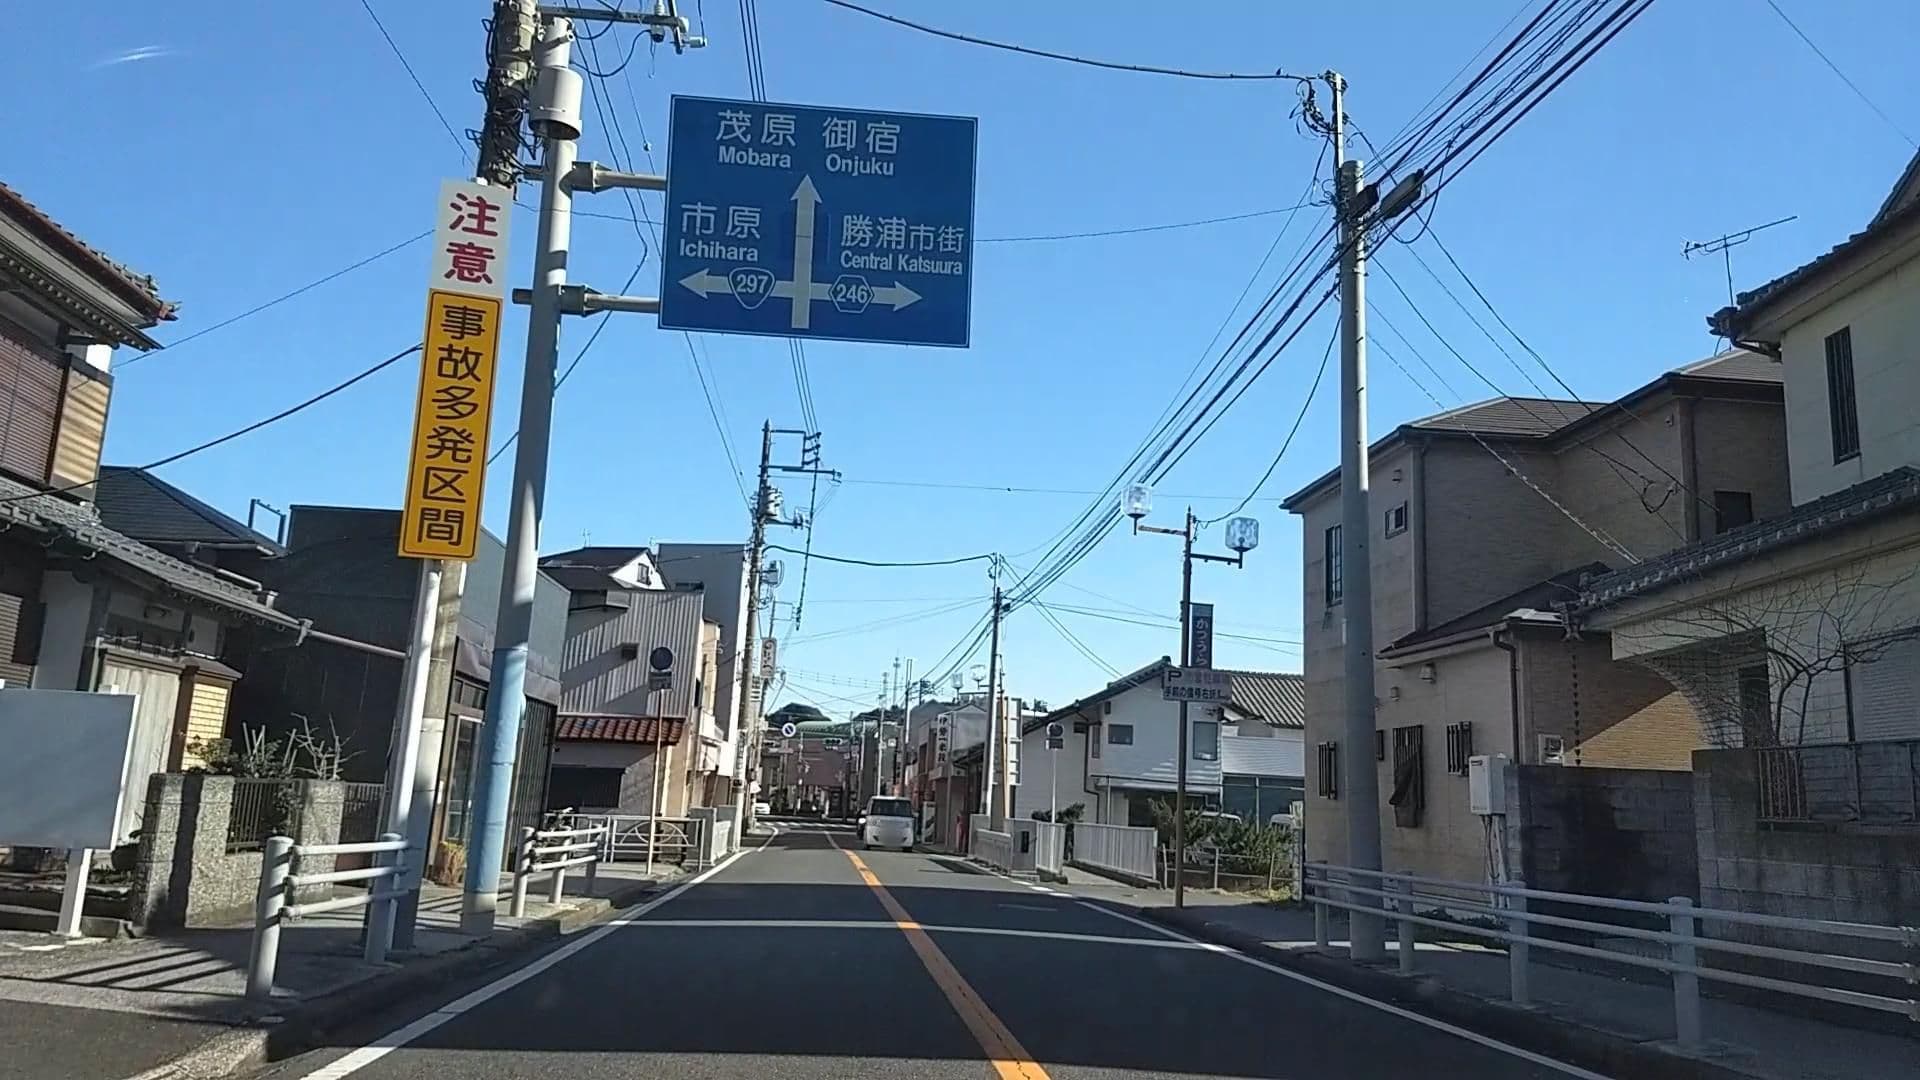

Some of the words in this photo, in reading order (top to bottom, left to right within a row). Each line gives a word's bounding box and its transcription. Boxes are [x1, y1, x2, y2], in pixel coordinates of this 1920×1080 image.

[716, 109, 797, 148] 茂原
[822, 116, 901, 154] 御宿
[718, 146, 792, 168] Mobara
[825, 154, 895, 177] Onjuku
[681, 201, 761, 240] 市原
[840, 214, 965, 254] 勝浦市街
[443, 191, 501, 286] 注意
[679, 238, 758, 262] Ichihara
[840, 250, 892, 271] Central
[898, 254, 963, 275] Katsuura
[735, 273, 769, 294] 297
[835, 284, 868, 304] 246
[416, 304, 487, 547] 事故多発区間
[1168, 670, 1182, 681] P
